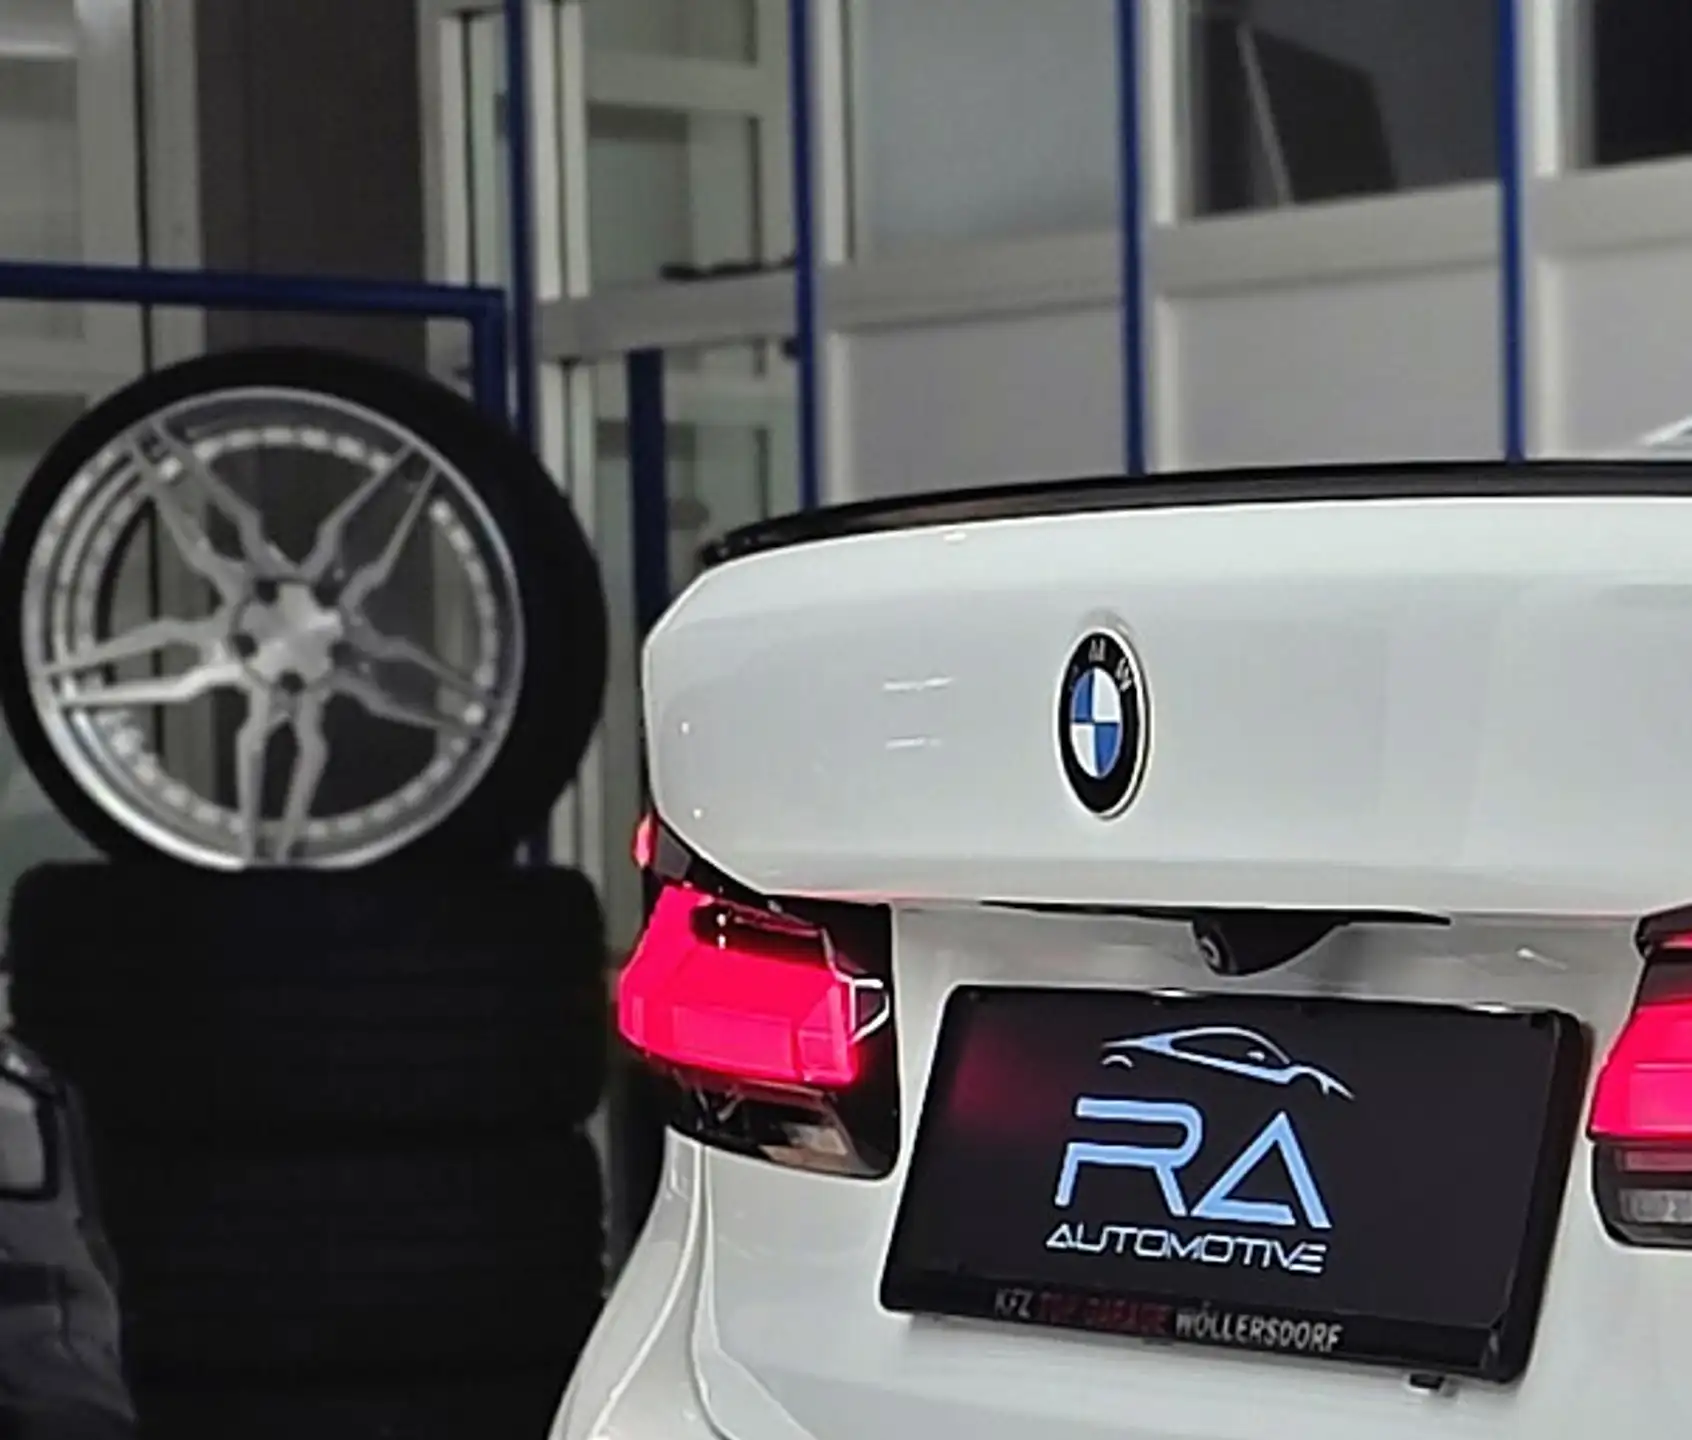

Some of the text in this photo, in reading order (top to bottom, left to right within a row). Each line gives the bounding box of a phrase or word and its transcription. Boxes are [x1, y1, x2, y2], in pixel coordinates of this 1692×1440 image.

[1055, 1097, 1332, 1229] RA
[1046, 1222, 1327, 1273] AUTOMOTIVE
[1176, 1300, 1343, 1352] WÖLLERSDORF
